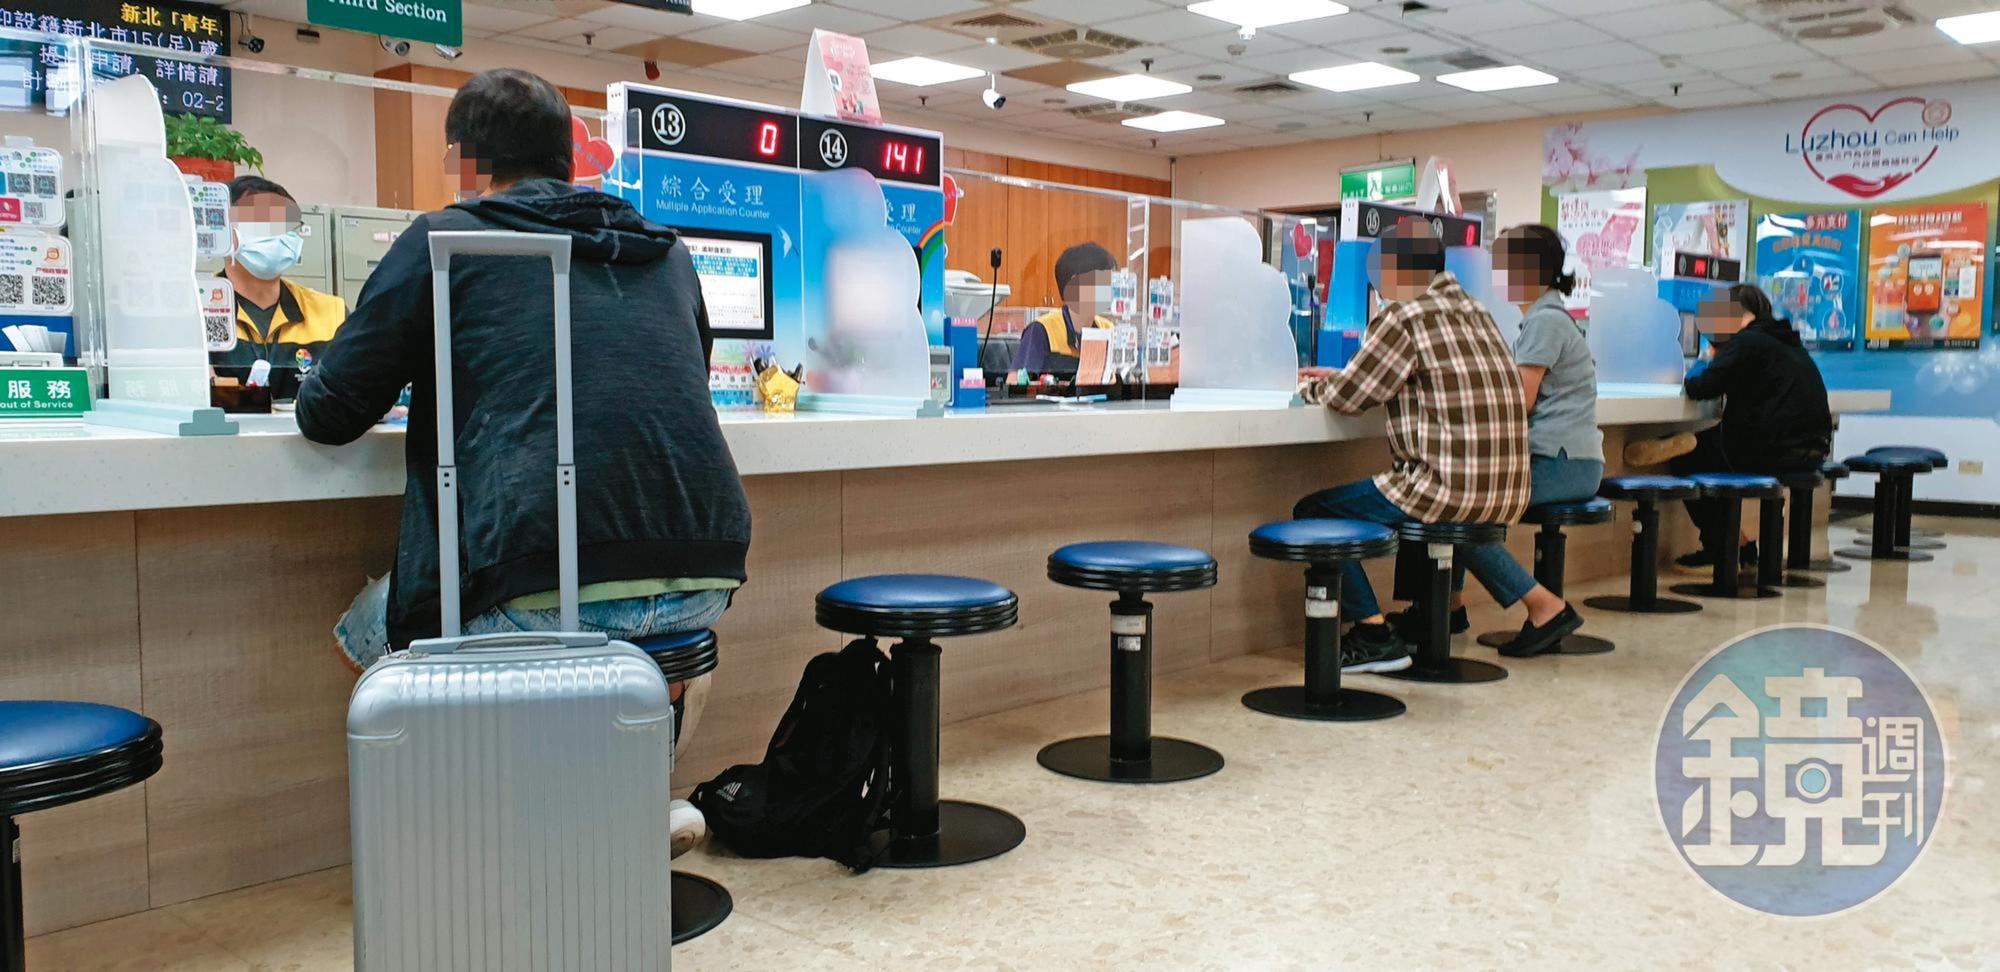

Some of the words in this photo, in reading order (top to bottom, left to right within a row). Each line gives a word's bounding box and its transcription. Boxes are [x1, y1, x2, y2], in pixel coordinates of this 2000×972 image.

[120, 3, 223, 36] 新北「青年
[328, 0, 378, 11] ird
[385, 0, 448, 23] Section
[656, 108, 682, 139] 13
[760, 123, 777, 154] 0
[823, 133, 844, 162] 14
[1785, 128, 1877, 153] Luzhou
[1884, 130, 1917, 145] Can
[1922, 125, 1960, 142] Help
[885, 142, 922, 174] 141
[661, 175, 764, 206] 綜合受理
[656, 199, 689, 212] Multiple
[691, 202, 738, 216] Application
[739, 207, 770, 219] Counter
[8, 380, 71, 399] 服務
[34, 400, 73, 409] Service
